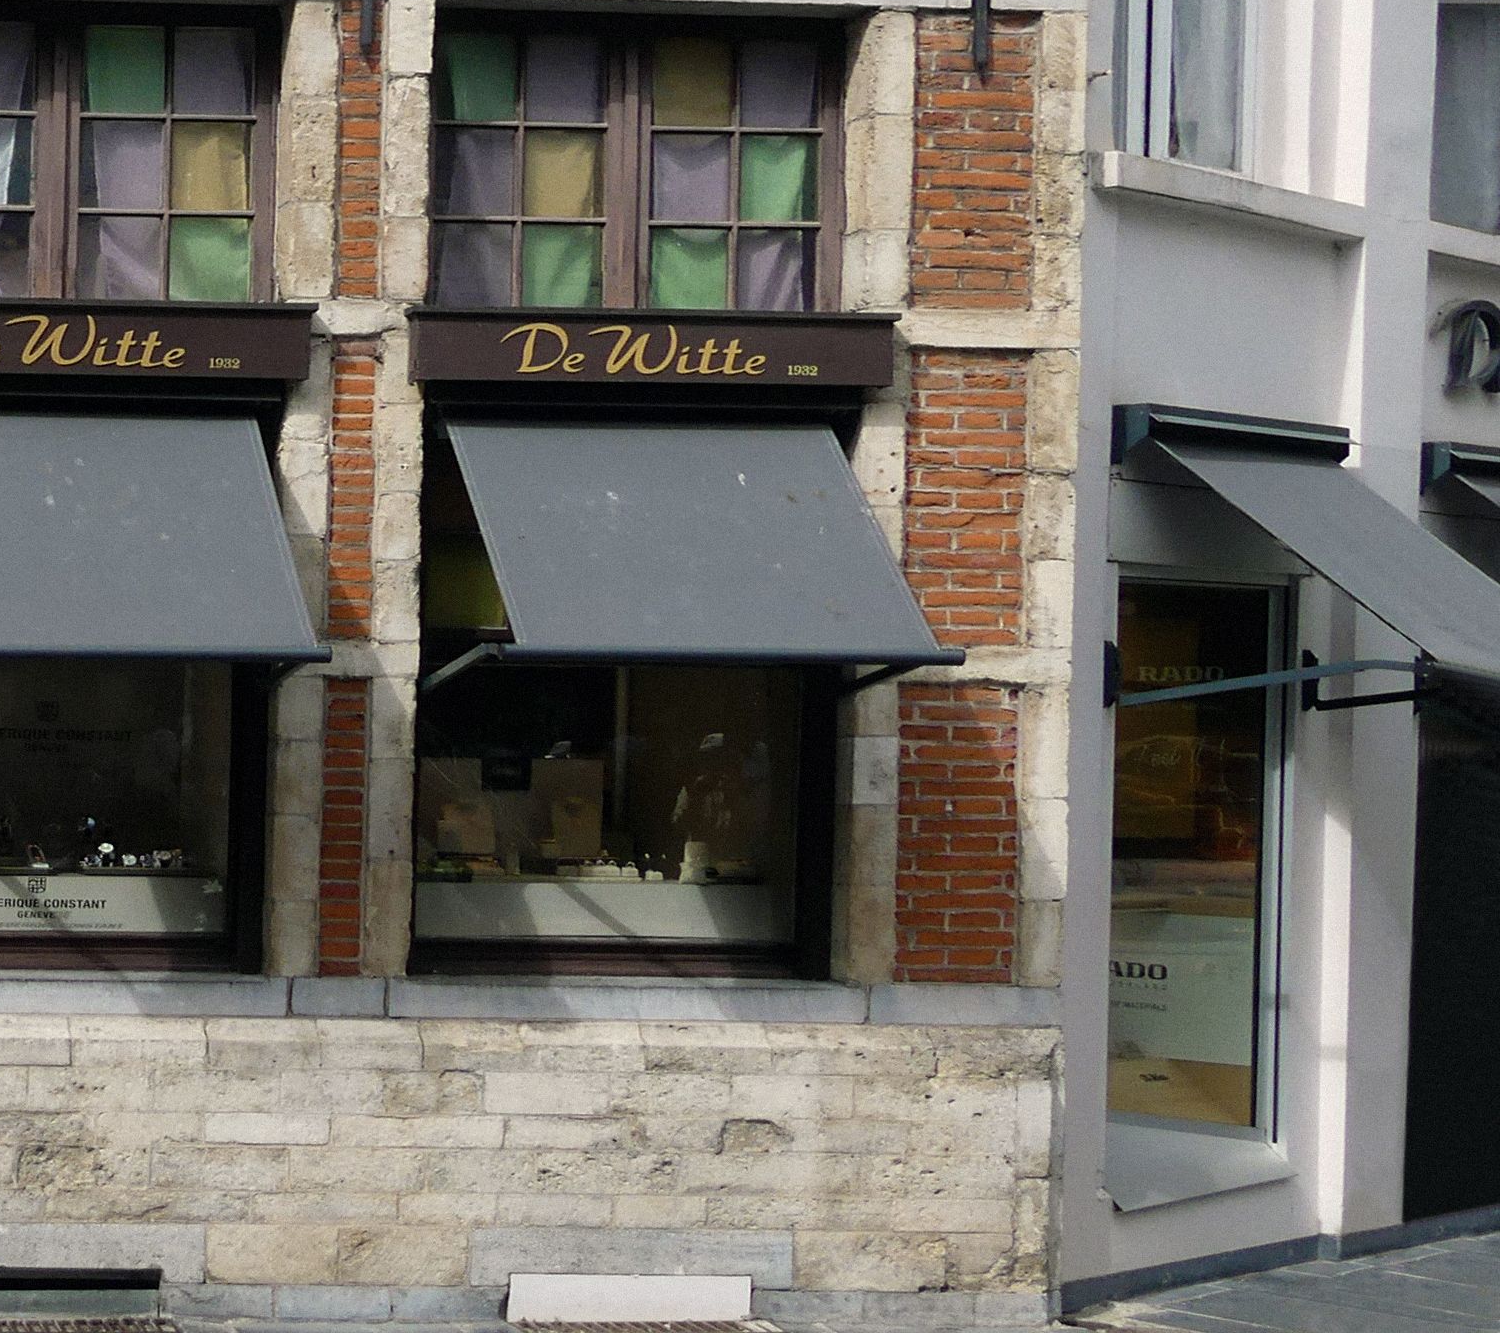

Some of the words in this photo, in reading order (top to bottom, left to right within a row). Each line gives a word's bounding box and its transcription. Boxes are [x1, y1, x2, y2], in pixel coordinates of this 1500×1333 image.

[6, 314, 185, 369] Witte
[209, 357, 241, 369] 1932
[500, 322, 585, 374] De
[588, 325, 766, 375] Witte
[787, 365, 818, 376] 1932
[44, 898, 107, 910] CONSTANT
[1109, 960, 1168, 980] ADO
